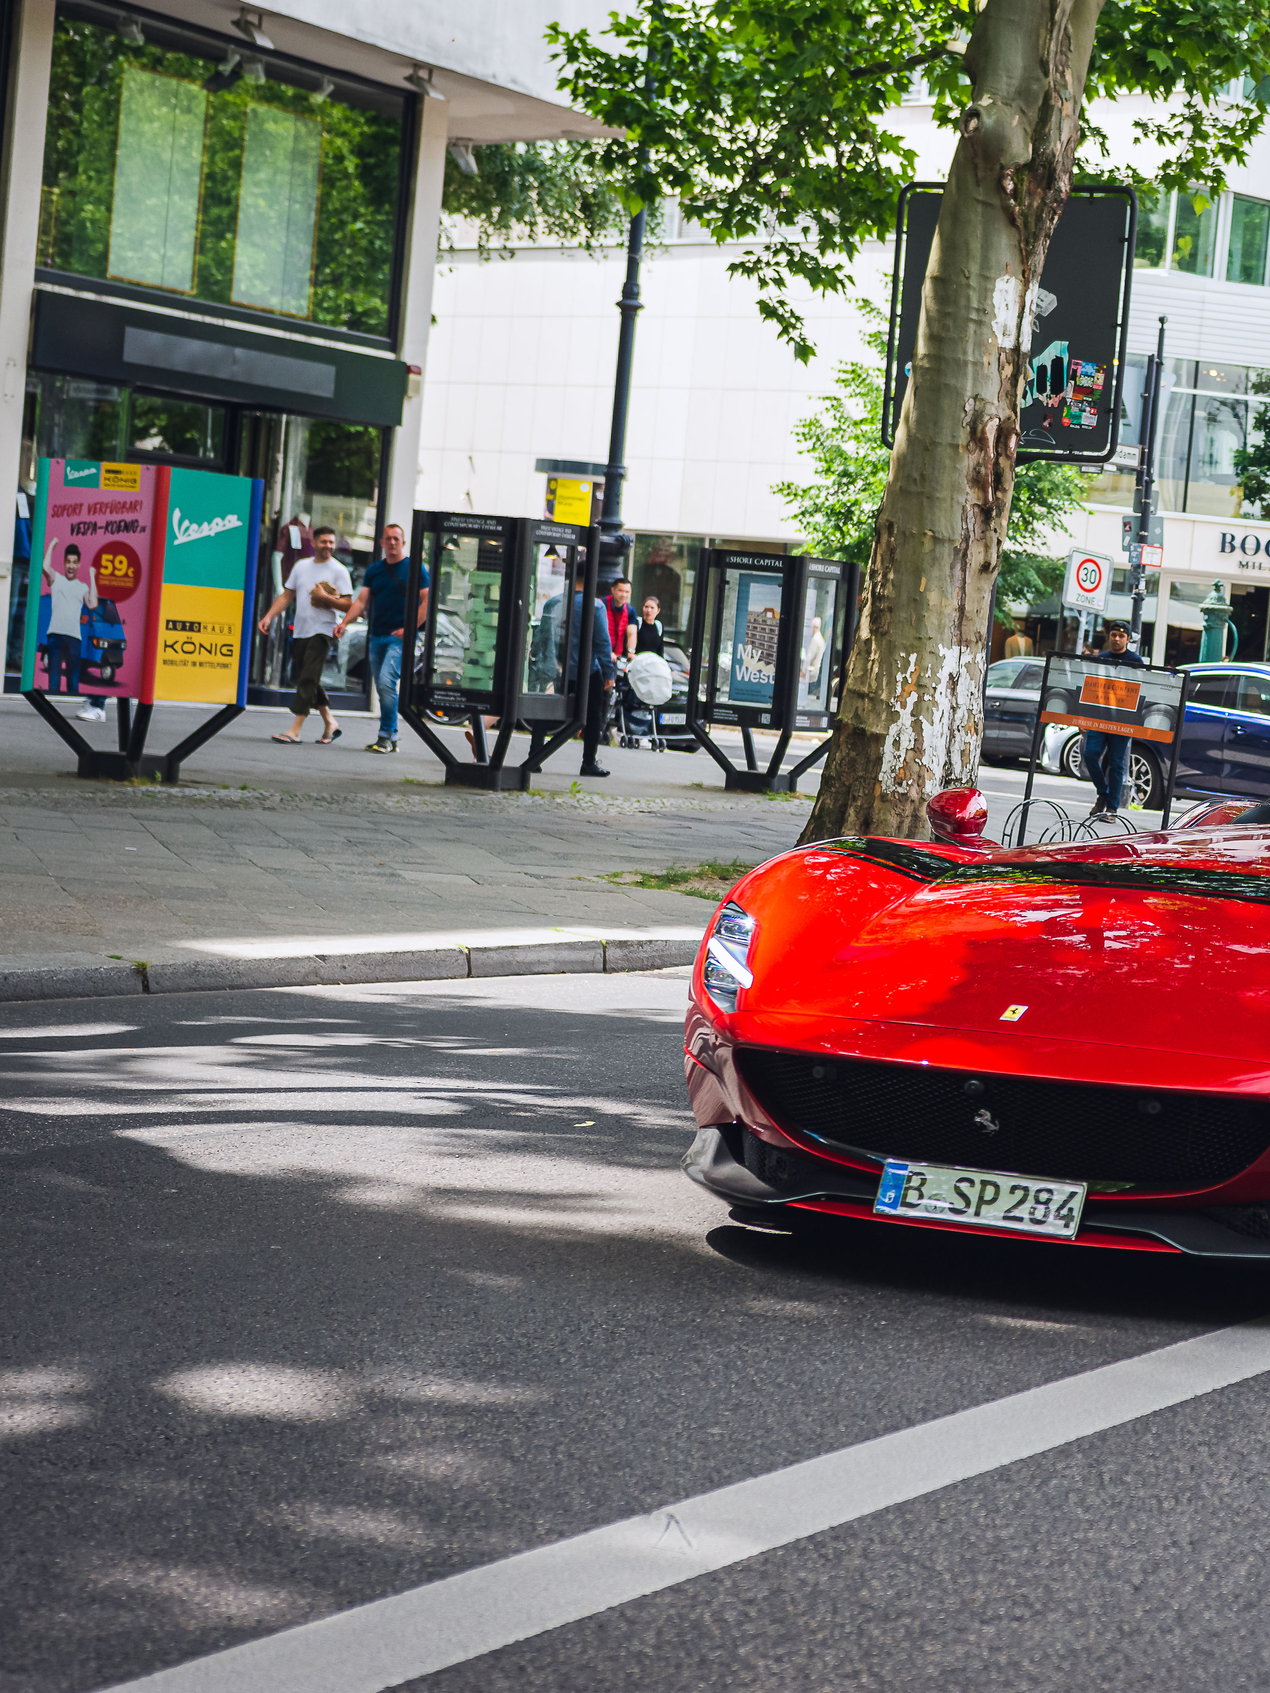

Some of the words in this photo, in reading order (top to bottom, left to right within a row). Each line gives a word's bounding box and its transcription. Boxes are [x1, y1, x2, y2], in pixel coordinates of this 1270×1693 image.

[51, 503, 83, 518] SOFORT
[87, 500, 143, 516] VERFÜGBAR!
[172, 507, 243, 546] Vespa
[754, 557, 784, 568] CAPITAL
[1081, 567, 1097, 584] 30
[1075, 593, 1096, 606] ZONE
[163, 637, 234, 657] KÖNIG
[737, 643, 762, 664] My
[163, 659, 190, 668] MOBILITÄT
[198, 661, 233, 670] MITTELPUNKT
[736, 665, 776, 684] West
[1099, 722, 1117, 731] BESTEN
[1117, 725, 1134, 734] LAGEN
[900, 1171, 927, 1209] B
[948, 1176, 1000, 1217] SP
[1002, 1184, 1079, 1229] 284
